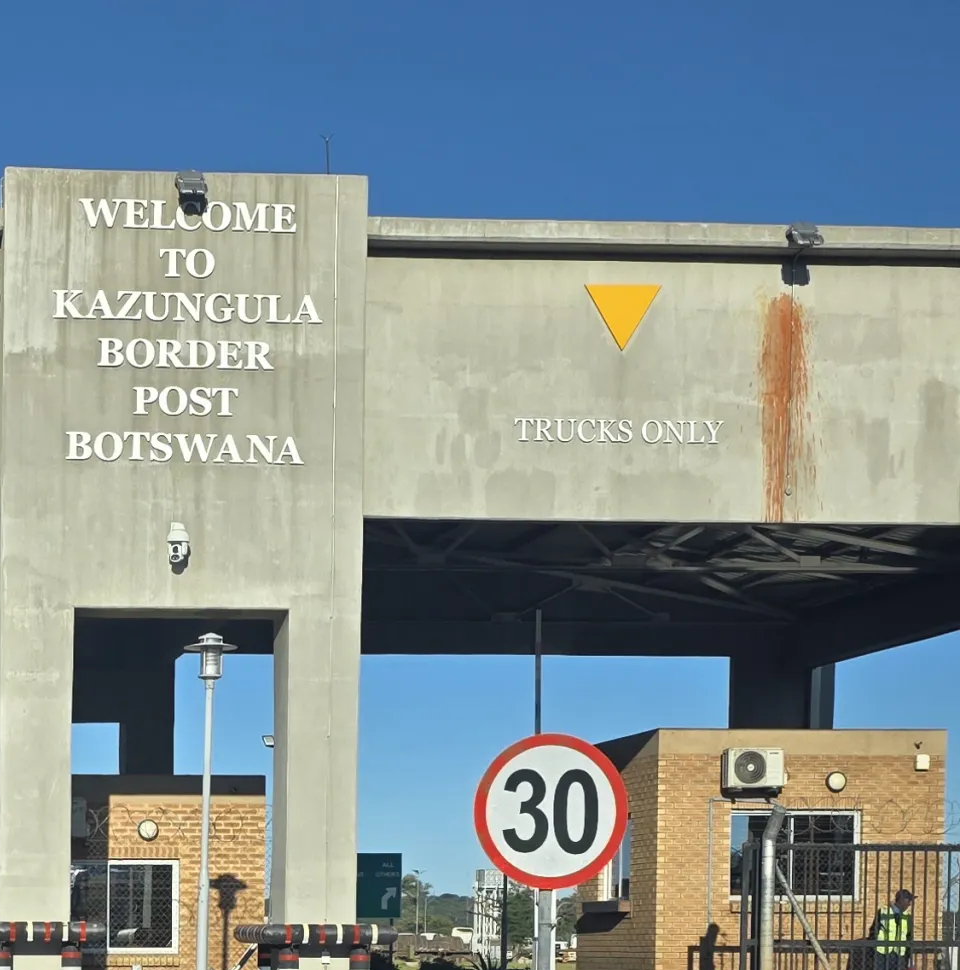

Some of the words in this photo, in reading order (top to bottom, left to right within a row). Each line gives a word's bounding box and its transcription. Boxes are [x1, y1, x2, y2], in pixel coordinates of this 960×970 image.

[79, 198, 297, 233] WELCOME
[159, 248, 215, 278] TO
[52, 289, 323, 323] KAZUNGULA
[97, 337, 274, 370] BORDER
[133, 386, 239, 416] POST
[514, 417, 633, 443] TRUCKS
[641, 419, 724, 444] ONLY
[65, 431, 305, 465] BOTSWANA
[502, 769, 598, 855] 30
